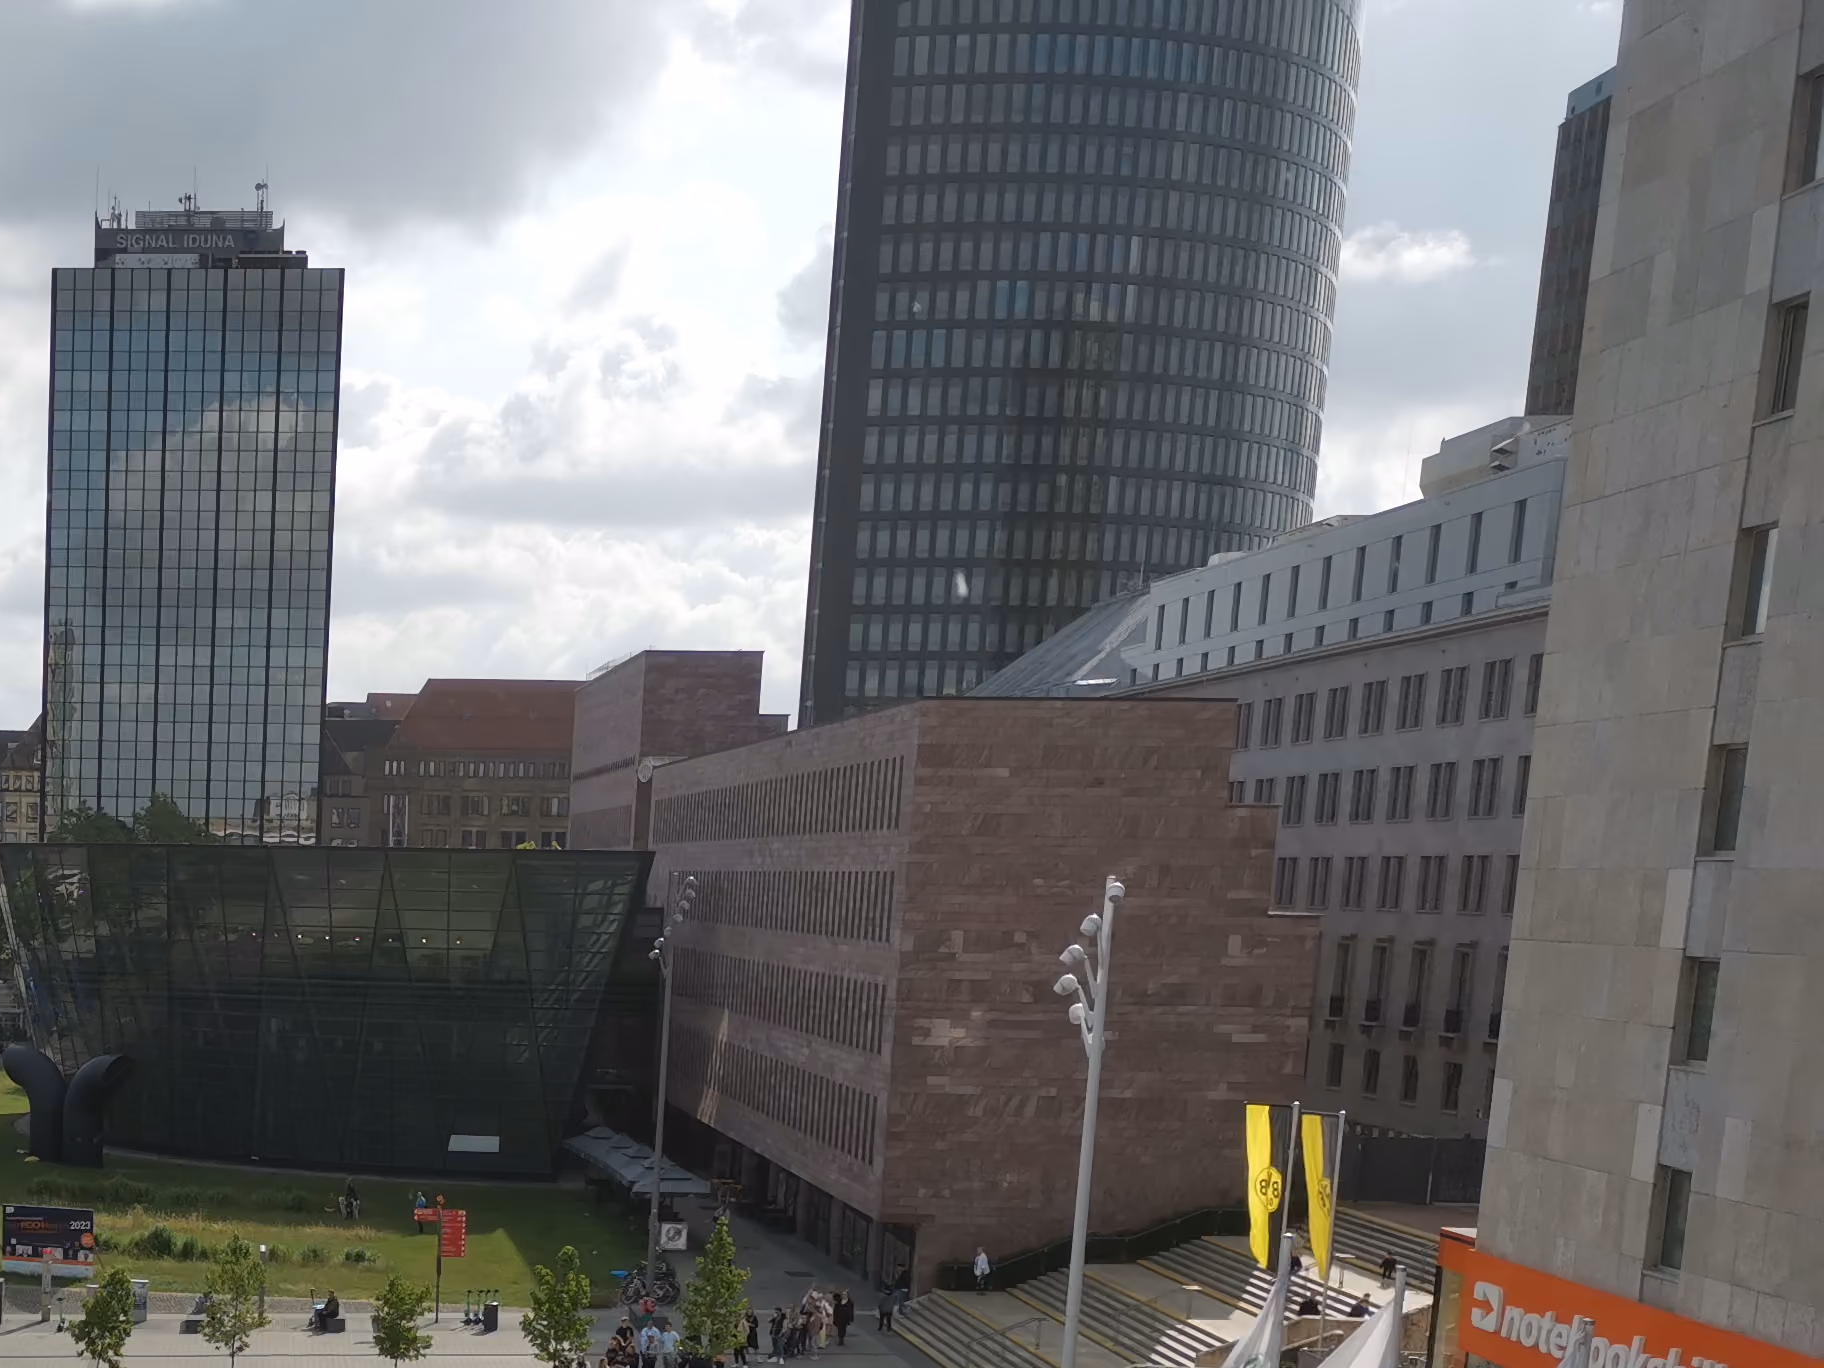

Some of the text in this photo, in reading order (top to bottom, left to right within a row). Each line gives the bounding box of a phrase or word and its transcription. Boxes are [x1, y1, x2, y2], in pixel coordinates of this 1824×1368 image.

[116, 234, 235, 248] SIGNAL IDUNA
[69, 1221, 91, 1230] 2023
